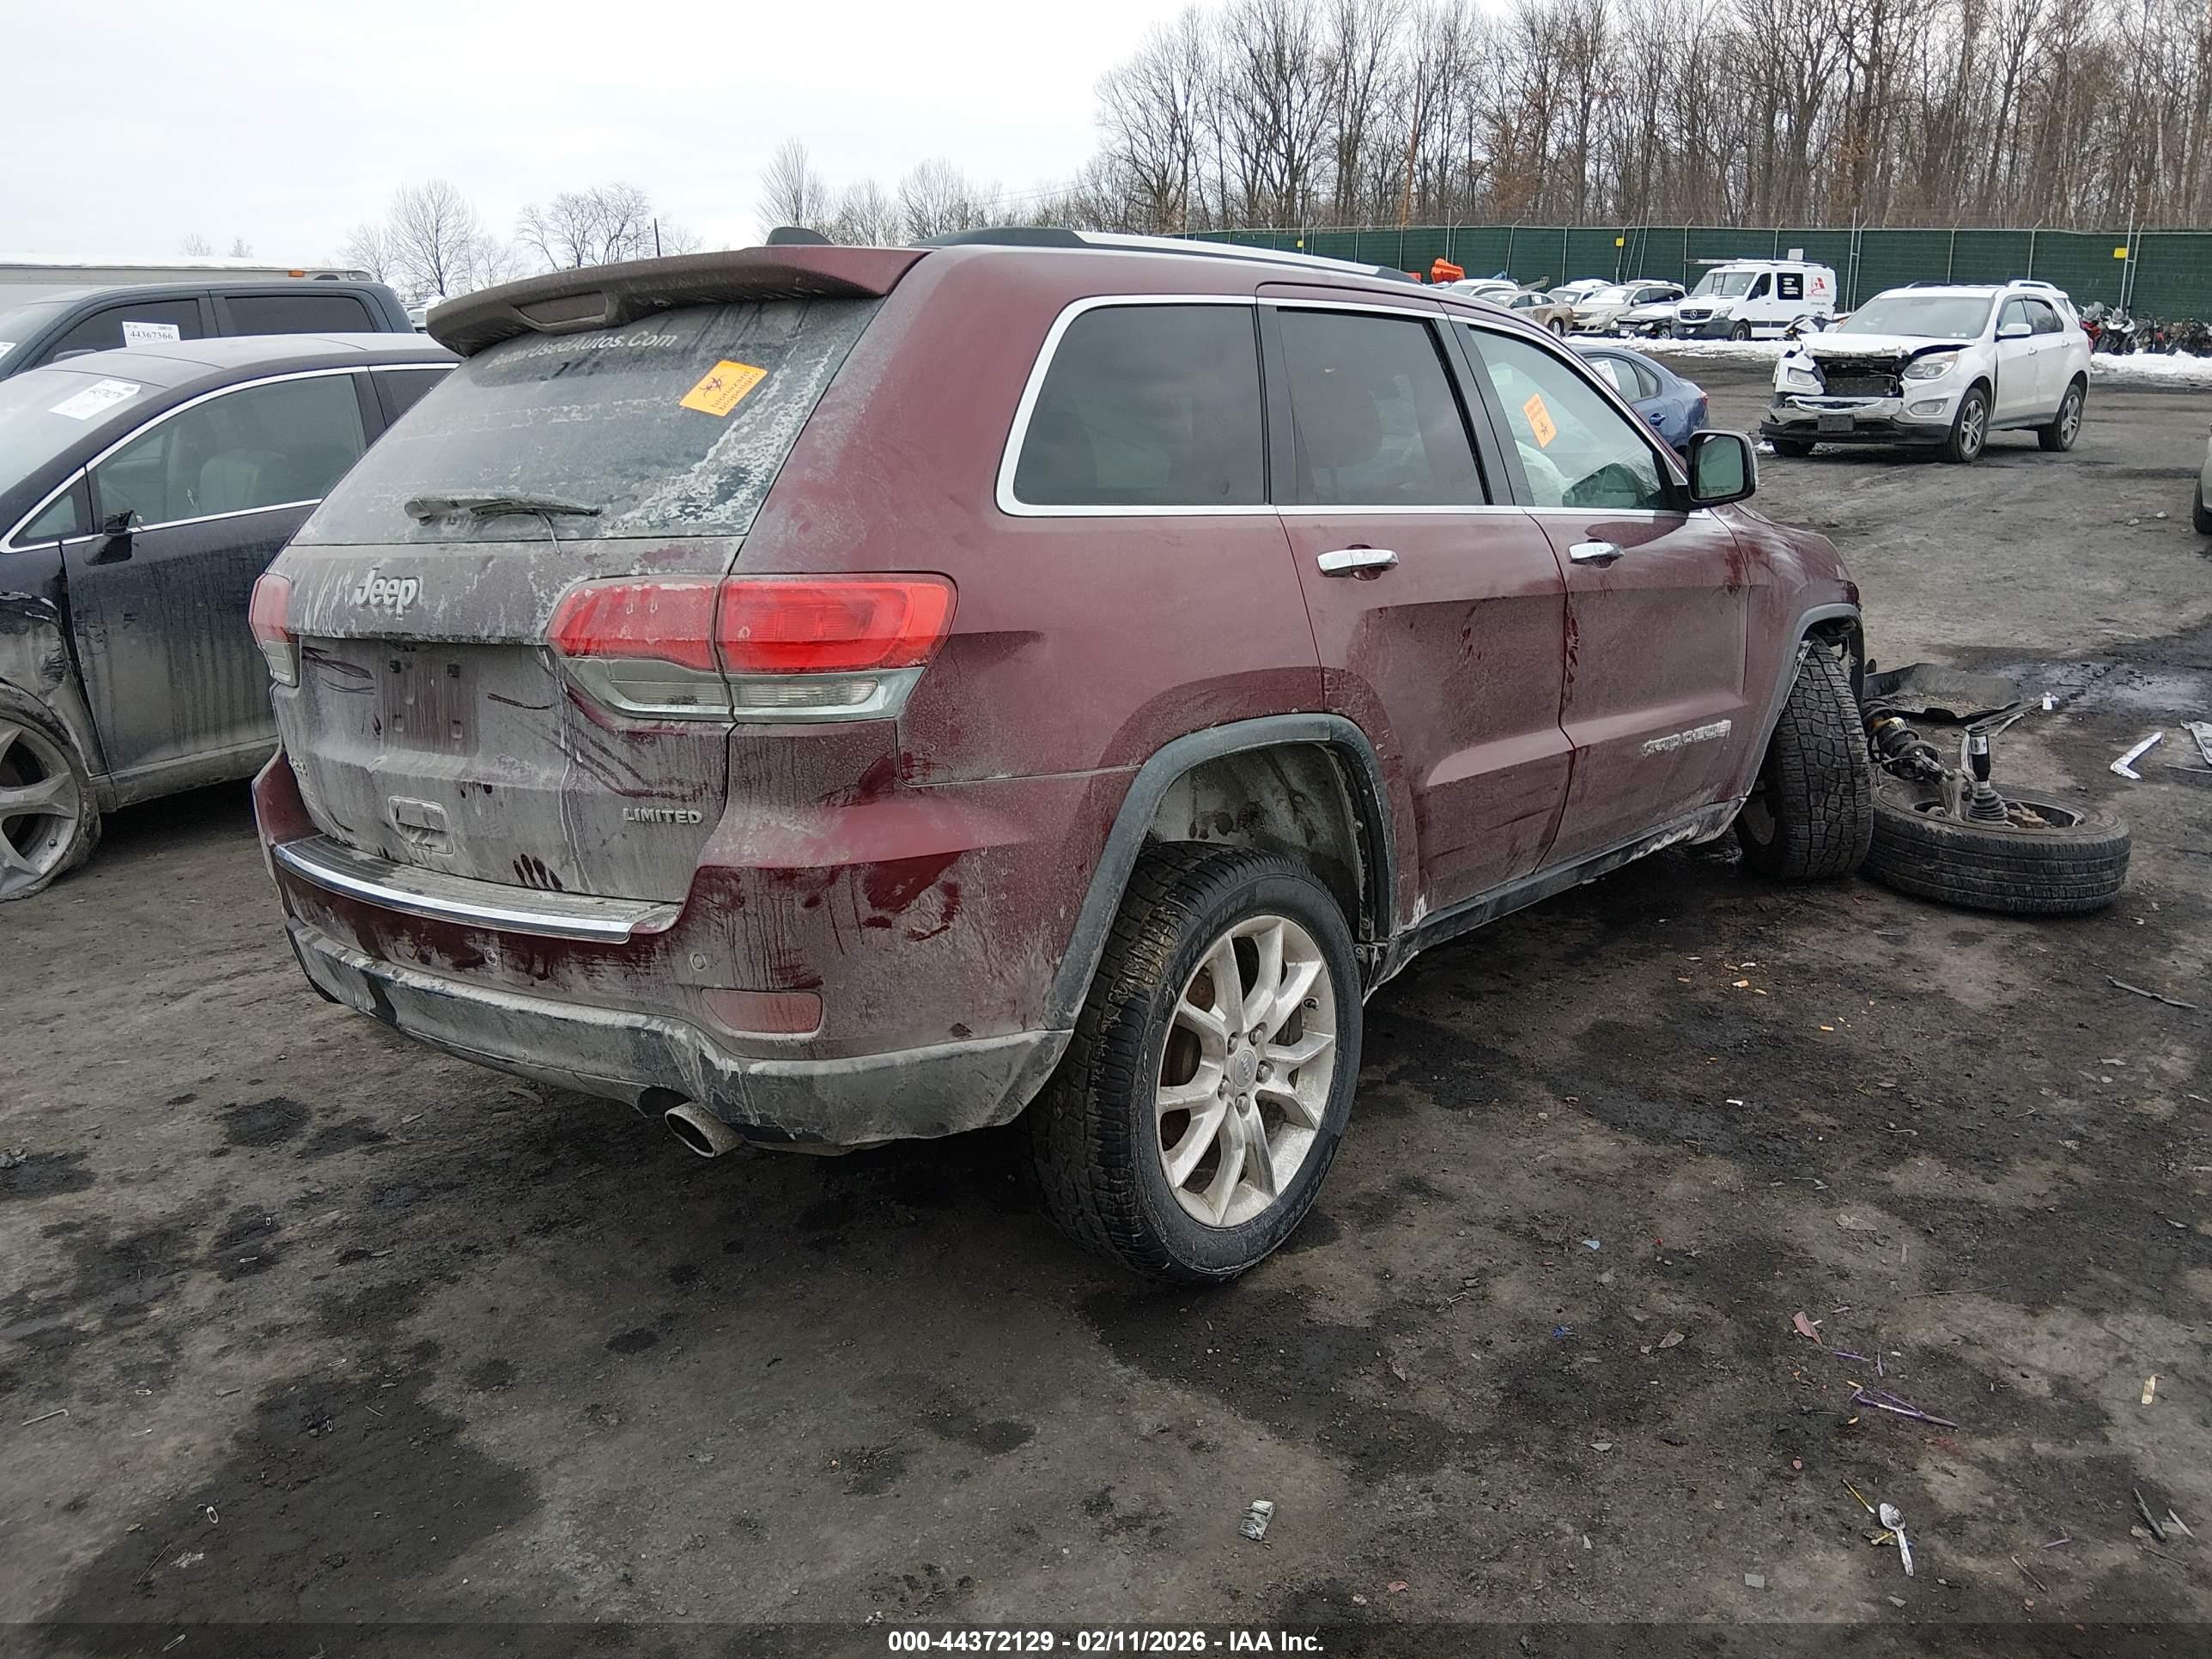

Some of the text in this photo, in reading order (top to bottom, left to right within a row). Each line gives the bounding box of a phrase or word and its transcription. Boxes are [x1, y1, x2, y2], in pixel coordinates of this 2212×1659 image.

[130, 331, 173, 340] 44367366
[353, 568, 419, 617] Jeep
[623, 807, 703, 825] LIMITED
